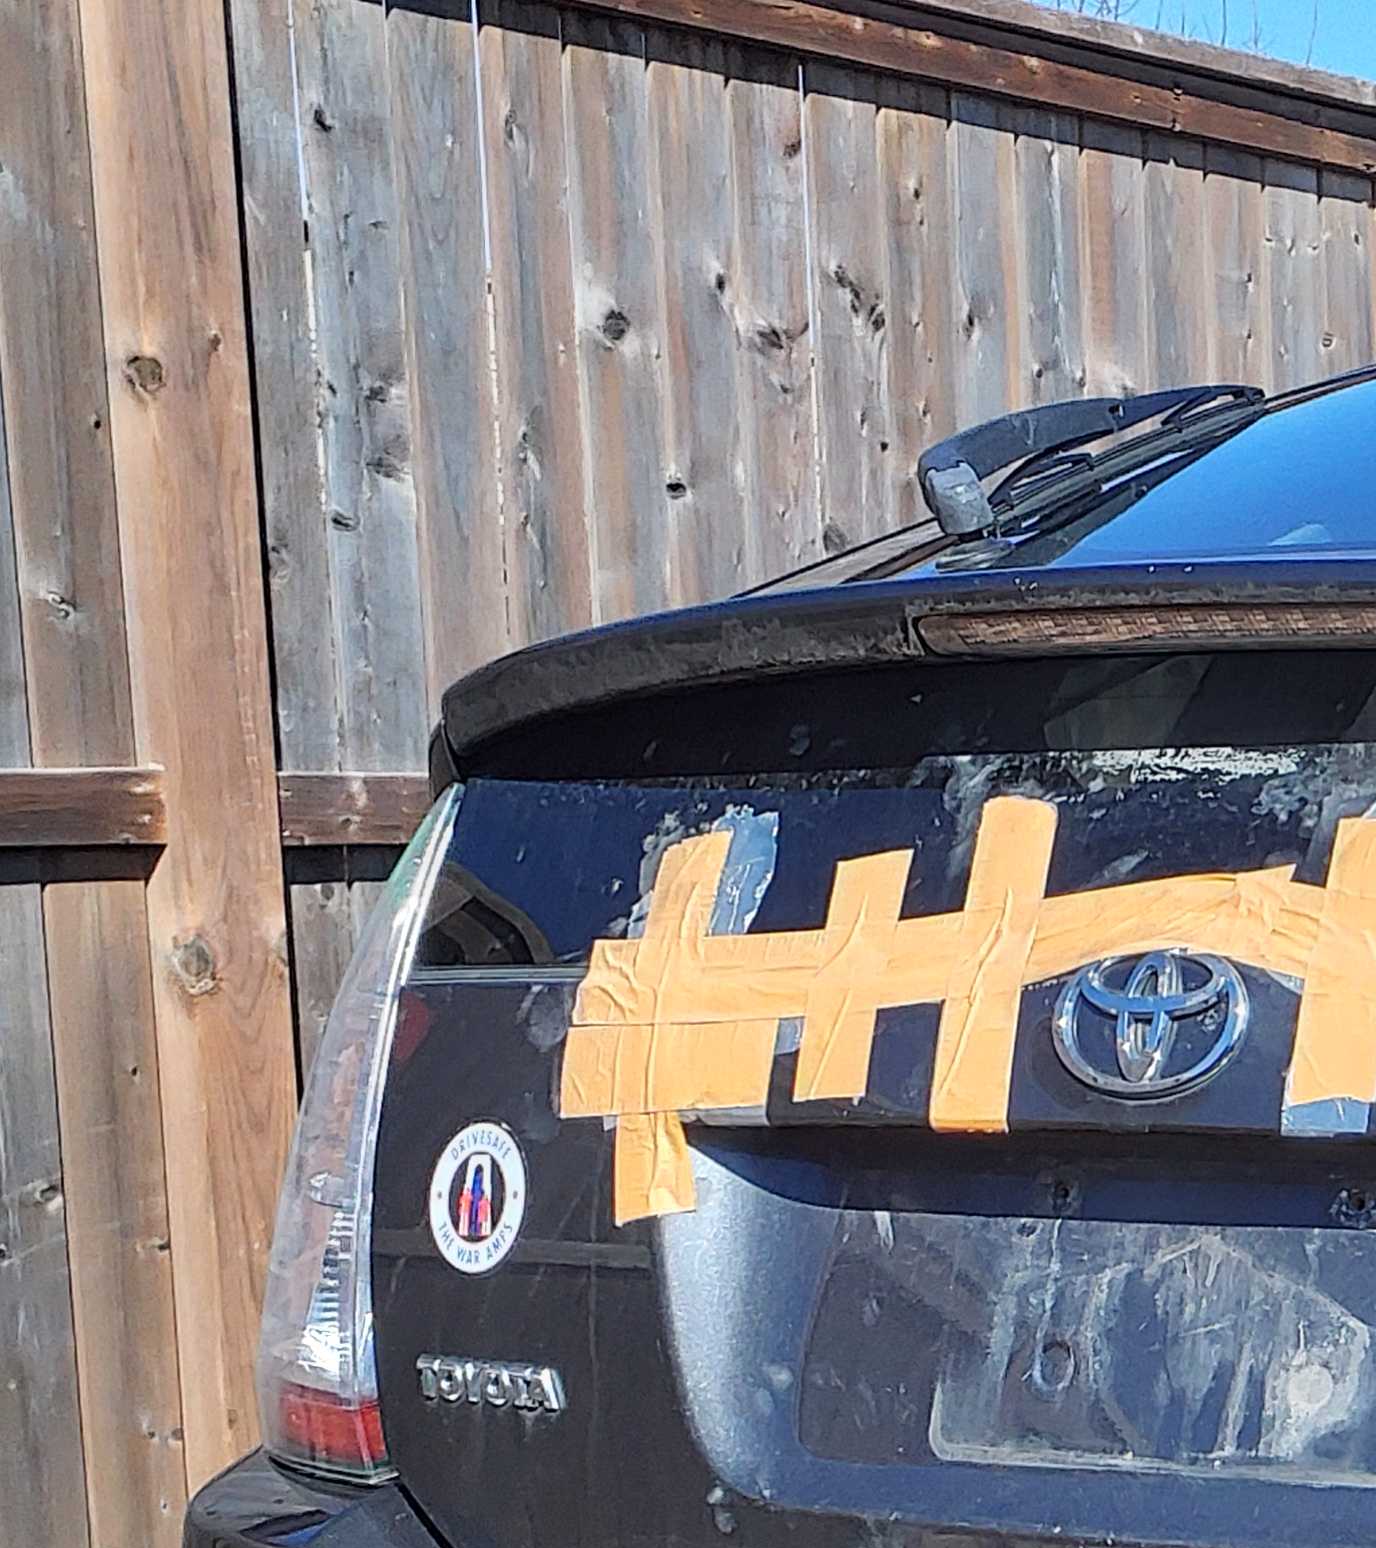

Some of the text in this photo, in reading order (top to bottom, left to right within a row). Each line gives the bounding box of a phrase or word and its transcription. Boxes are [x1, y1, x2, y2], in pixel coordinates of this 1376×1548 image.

[450, 1130, 512, 1160] DRIVESAFE
[439, 1222, 513, 1265] THE WAR AMPS
[416, 1353, 566, 1412] TOYOTA
